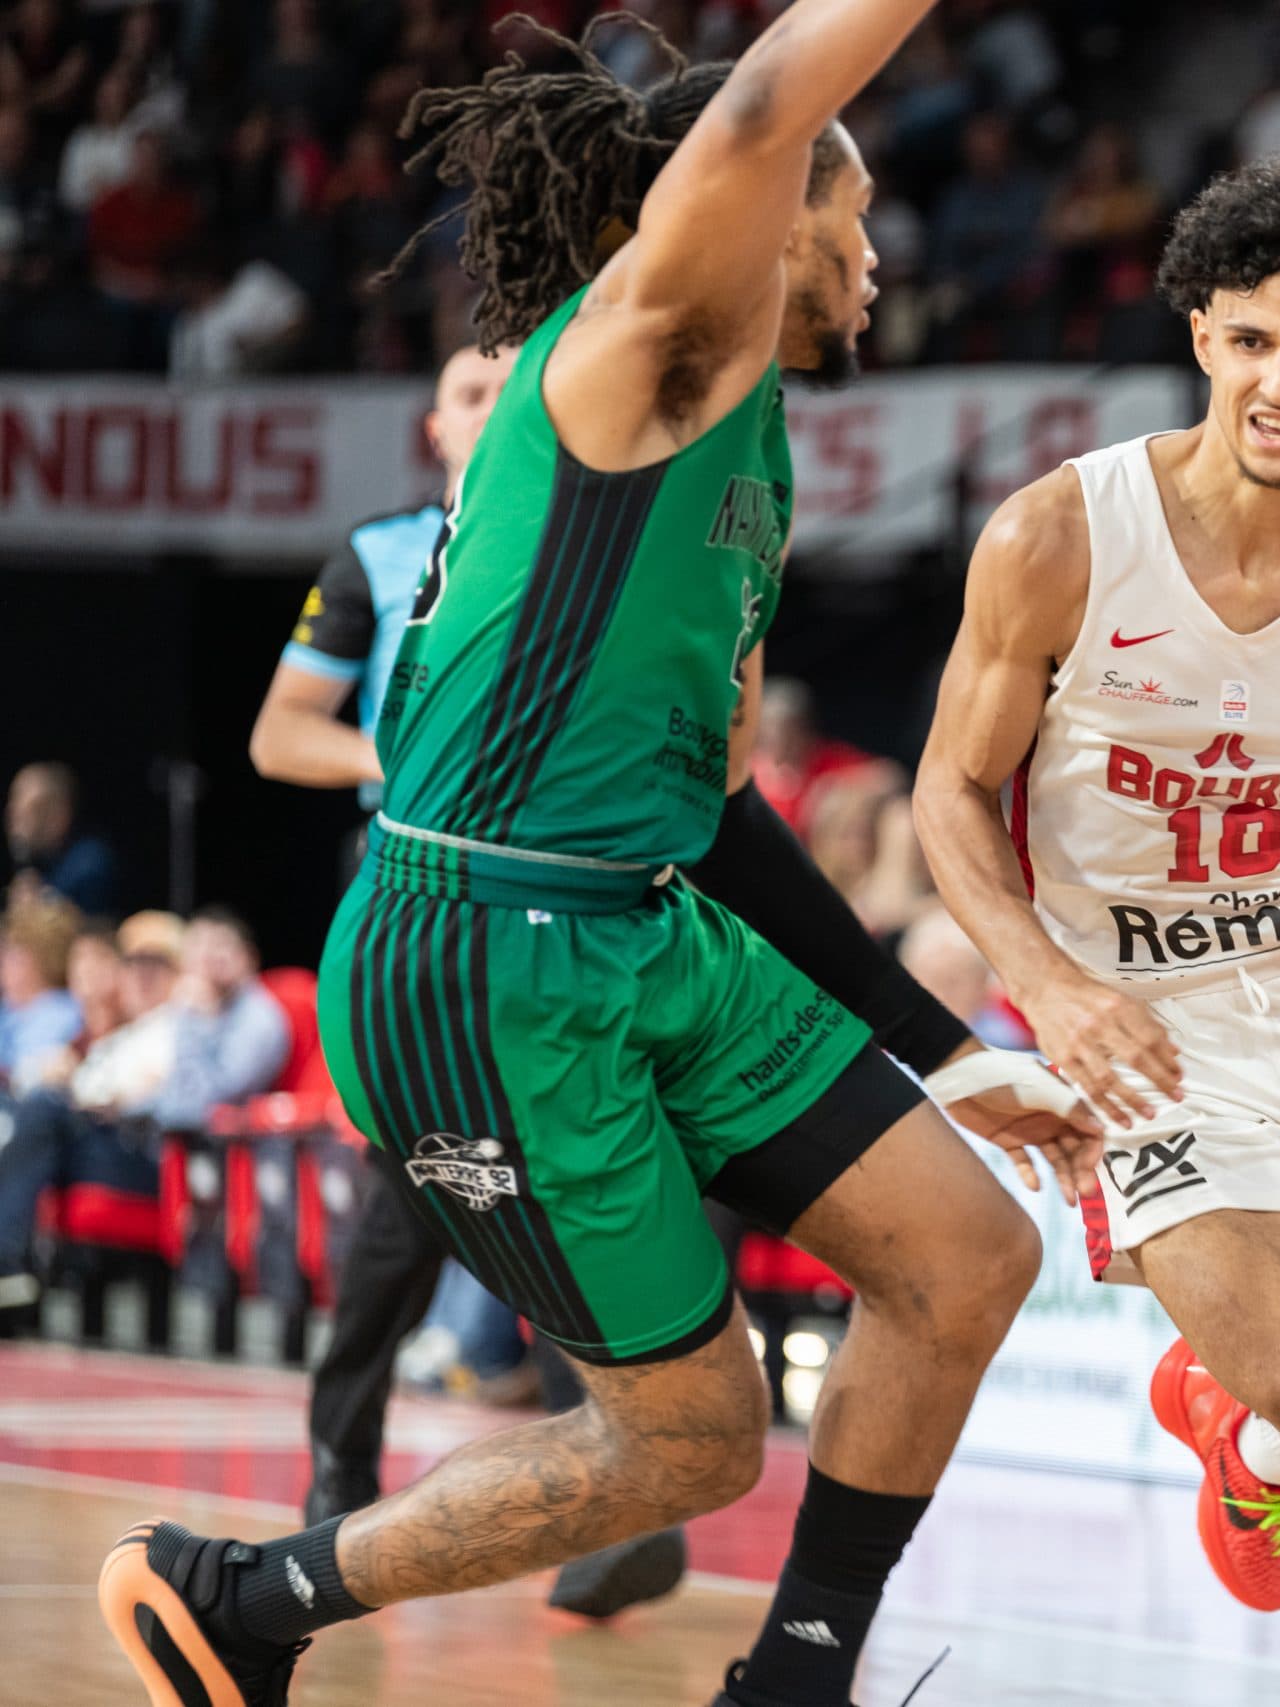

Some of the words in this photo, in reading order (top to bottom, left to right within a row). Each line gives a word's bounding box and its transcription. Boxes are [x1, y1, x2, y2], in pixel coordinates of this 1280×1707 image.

[0, 405, 322, 516] NOUS
[1101, 671, 1133, 690] Sun
[488, 1168, 513, 1192] 92
